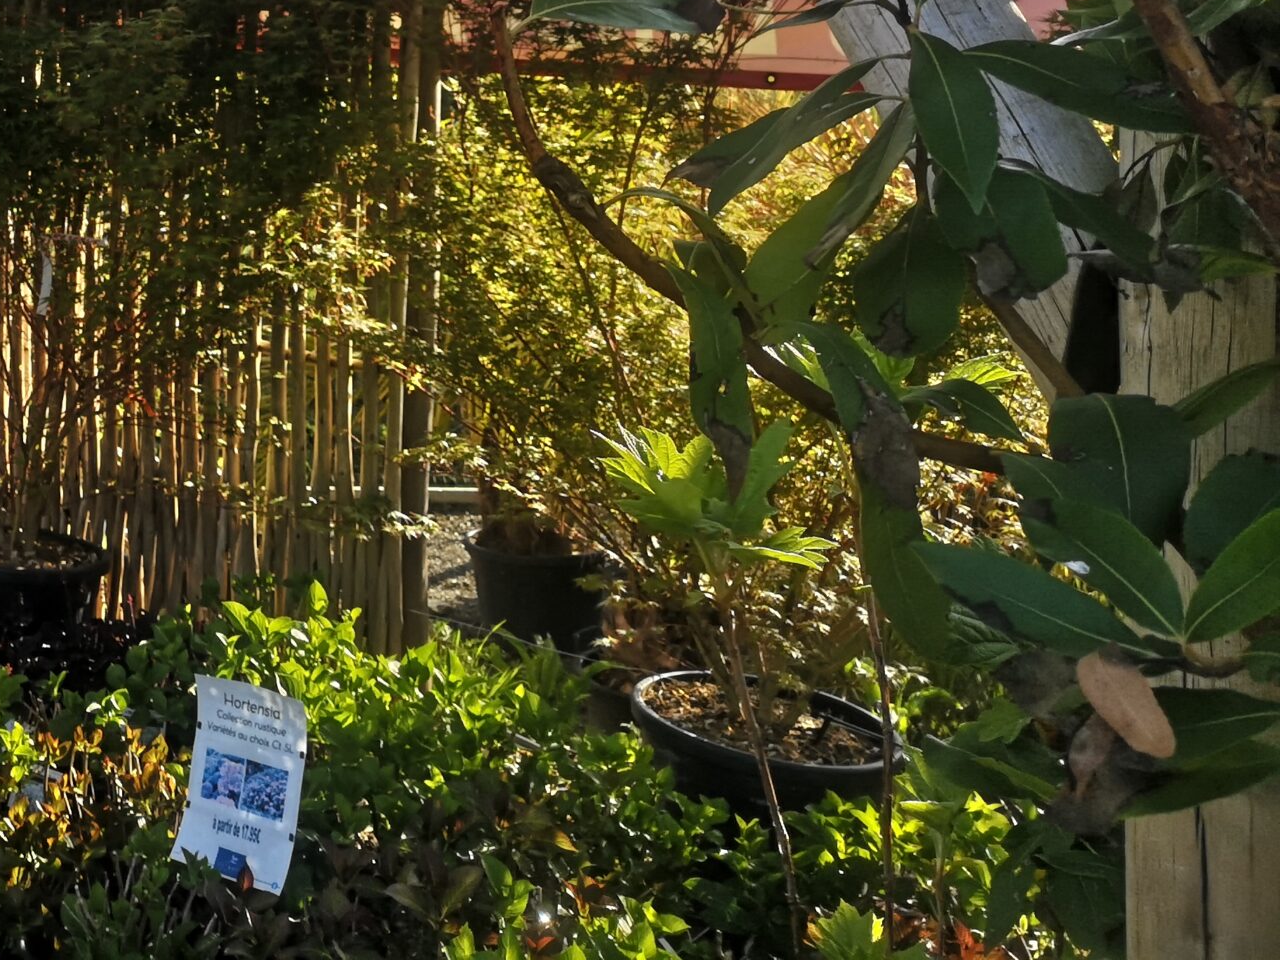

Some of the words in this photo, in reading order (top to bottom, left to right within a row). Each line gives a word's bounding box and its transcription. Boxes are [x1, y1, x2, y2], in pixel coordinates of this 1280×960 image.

[223, 692, 281, 720] Hortensia
[207, 721, 236, 737] Variétés
[238, 732, 248, 741] au
[249, 734, 270, 747] choix
[254, 722, 287, 737] rustique
[216, 818, 233, 835] partir
[233, 821, 240, 838] de
